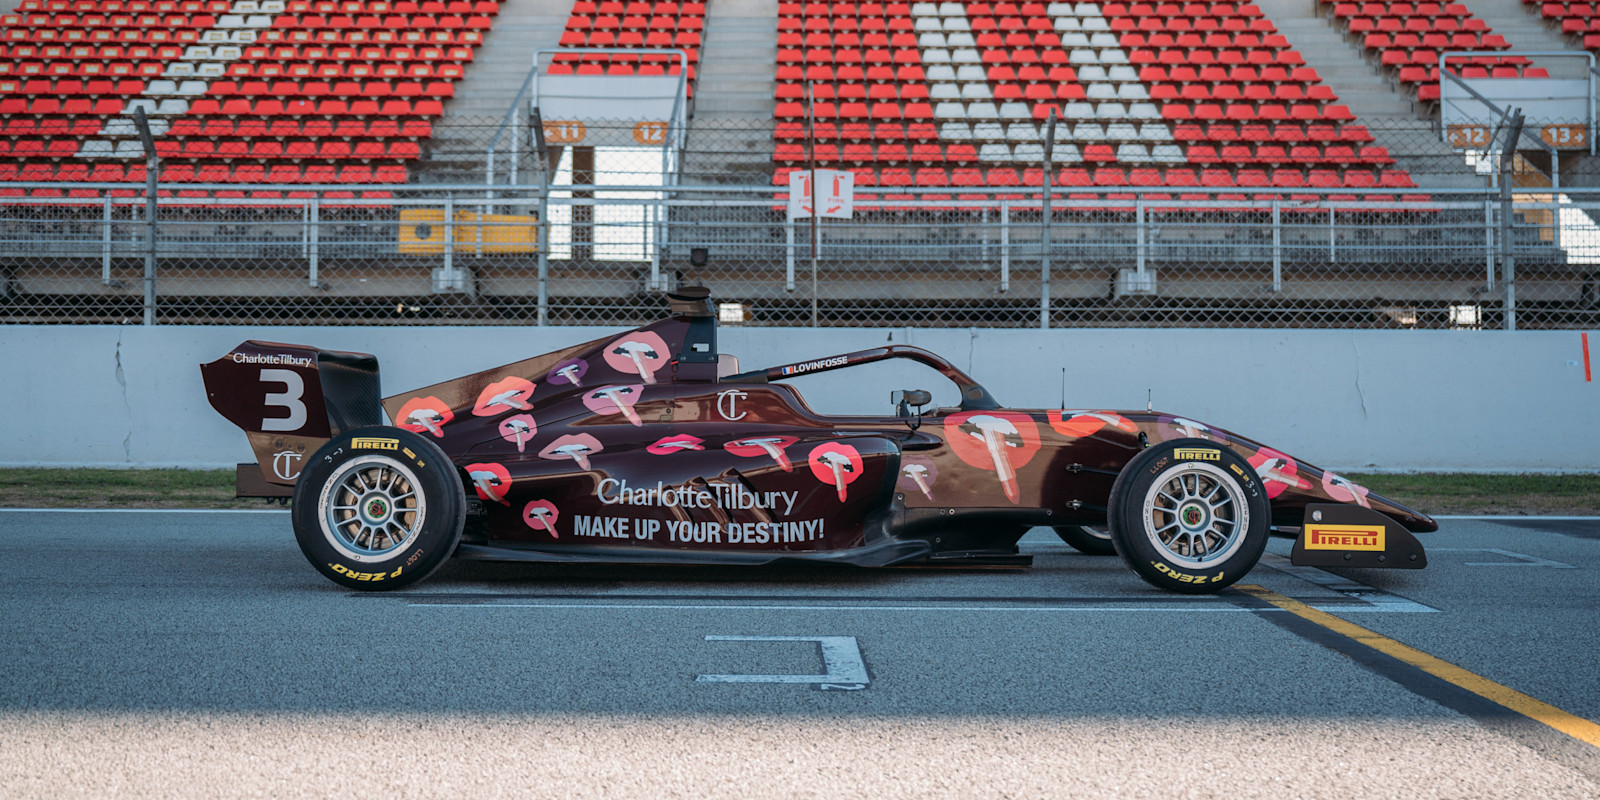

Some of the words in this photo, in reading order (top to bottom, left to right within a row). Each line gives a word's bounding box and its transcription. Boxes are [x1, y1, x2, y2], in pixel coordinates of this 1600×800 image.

[557, 123, 579, 139] 11
[640, 125, 662, 141] 12
[1462, 127, 1485, 143] 12
[1547, 127, 1571, 143] 13
[793, 356, 848, 374] LOVINFOSSE
[259, 368, 308, 432] 3
[351, 437, 400, 451] PIRELLI
[1173, 447, 1221, 461] PIRELLI
[574, 515, 629, 539] MAKE
[635, 518, 661, 541] UP
[666, 520, 722, 543] YOUR
[728, 518, 825, 544] DESTINY!
[1311, 529, 1378, 546] PIRELLI
[331, 563, 387, 581] ZERO
[390, 565, 403, 578] P
[1154, 562, 1208, 584] ZERO
[1211, 571, 1224, 583] P
